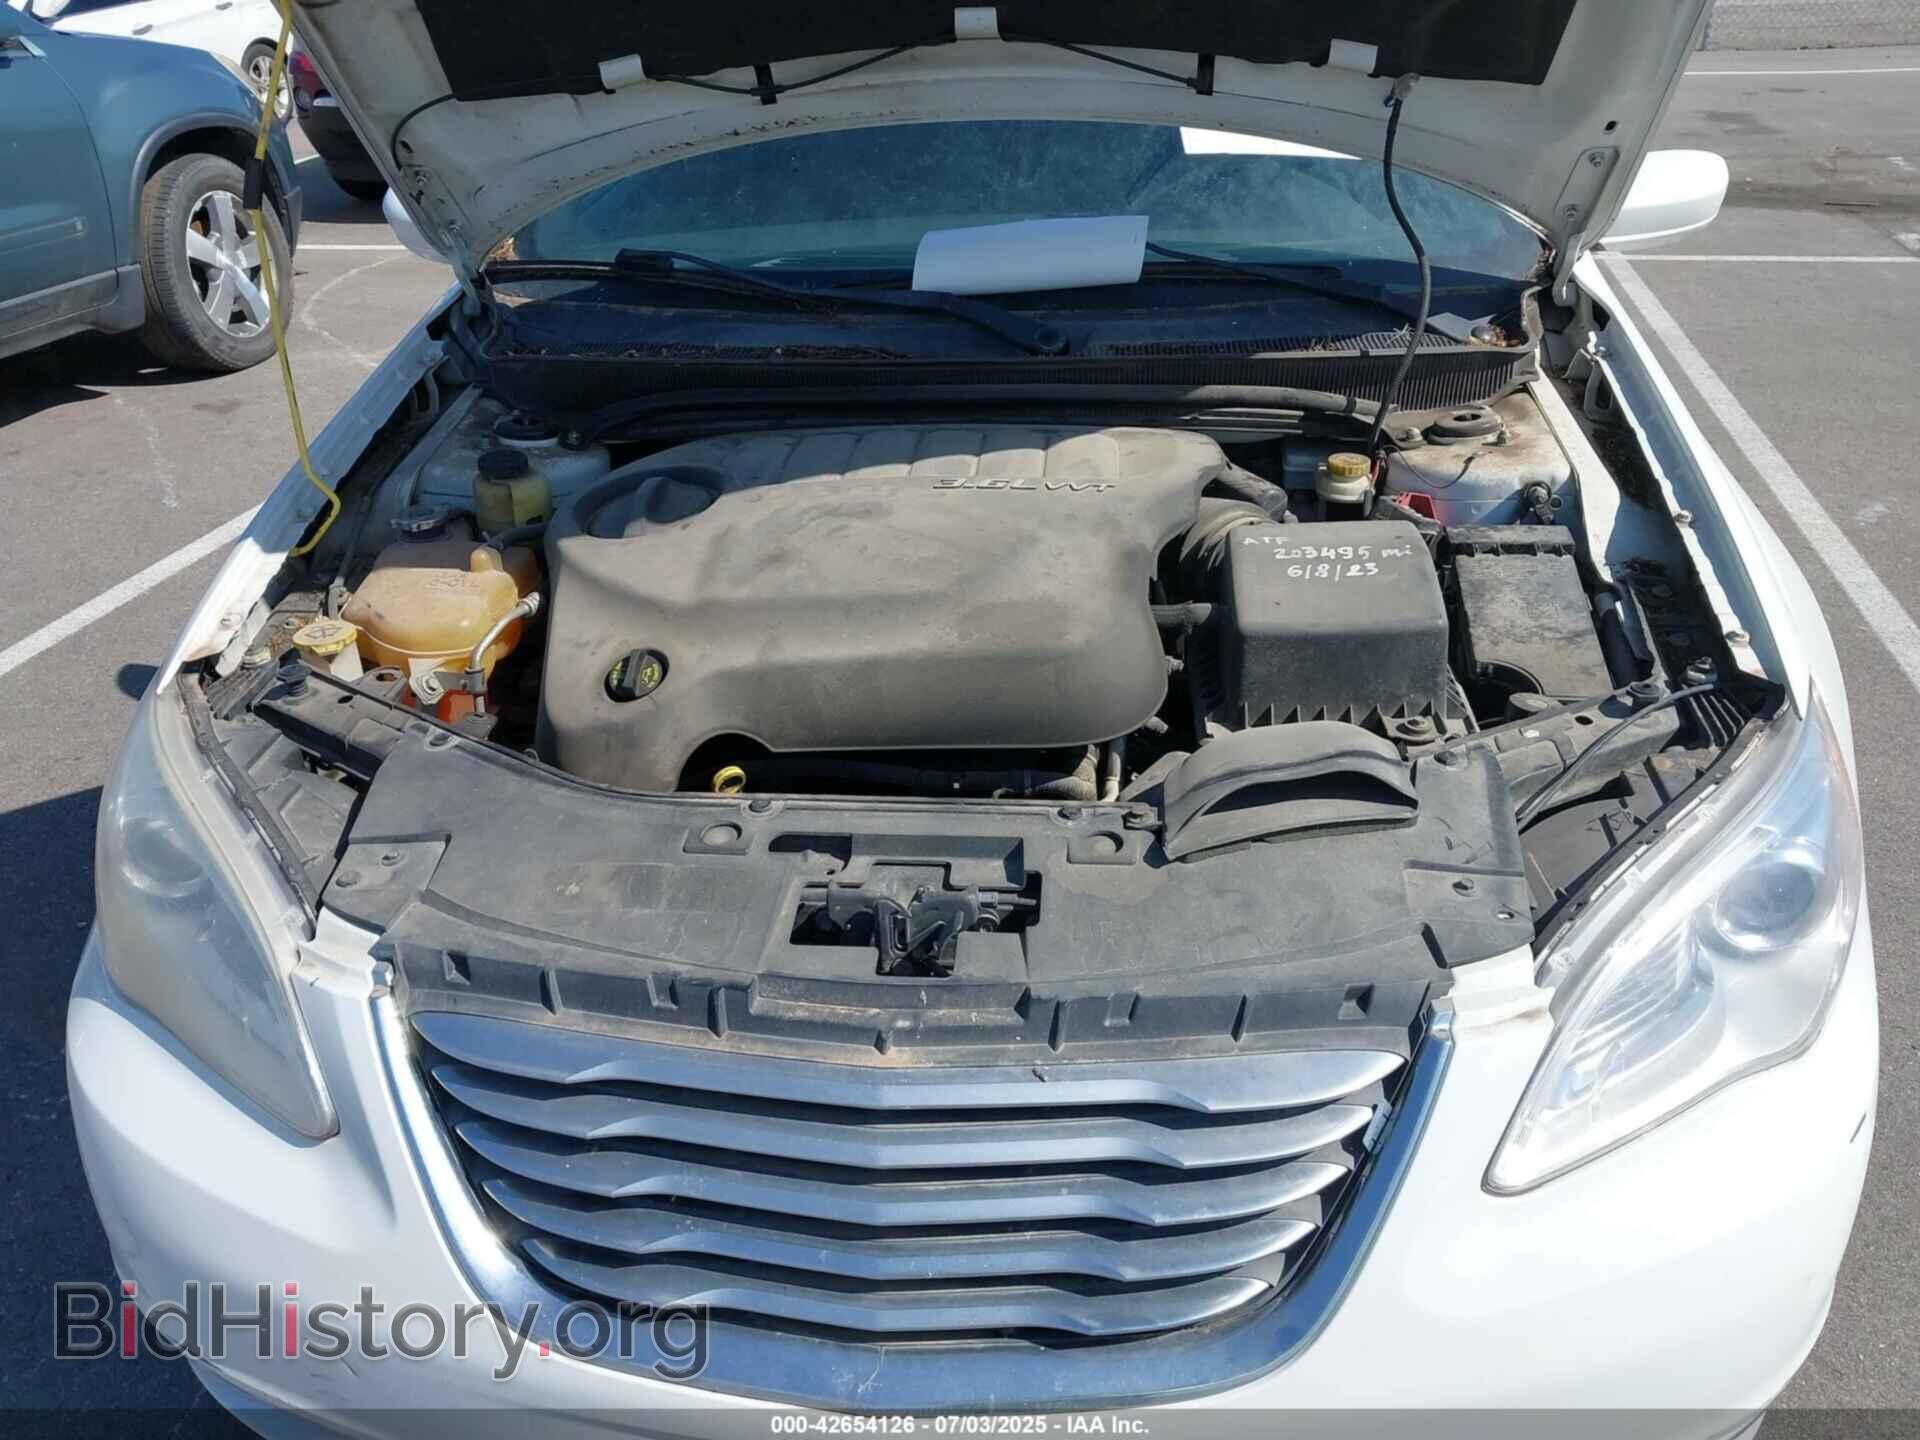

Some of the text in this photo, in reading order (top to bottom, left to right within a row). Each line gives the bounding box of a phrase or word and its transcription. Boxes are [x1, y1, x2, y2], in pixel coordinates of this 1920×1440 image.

[933, 479, 1115, 492] 3.6L VVT
[1243, 536, 1289, 545] ATF
[1273, 544, 1413, 560] 203495 mi
[1287, 562, 1379, 581] 6/8/23
